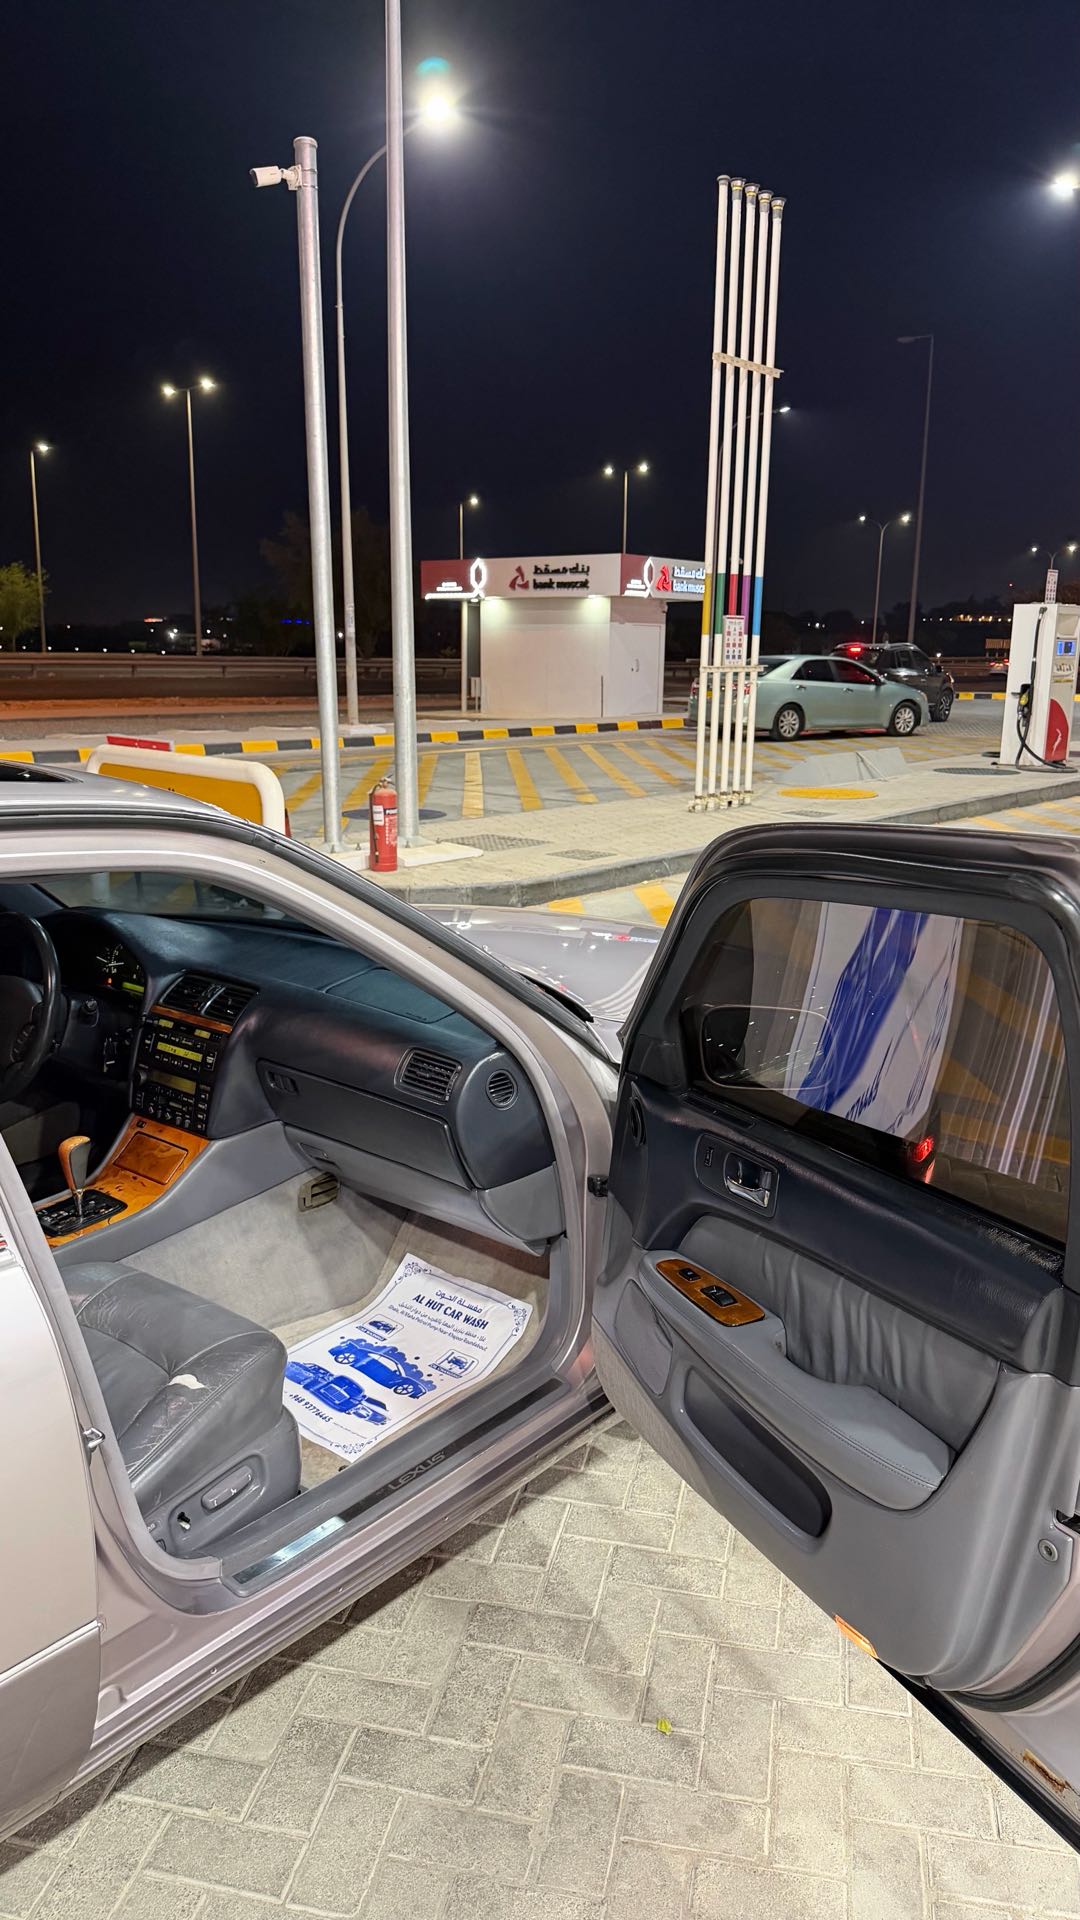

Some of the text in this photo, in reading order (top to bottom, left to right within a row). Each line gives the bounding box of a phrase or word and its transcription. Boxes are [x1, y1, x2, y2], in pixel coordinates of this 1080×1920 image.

[533, 562, 590, 577] بنك مسقط
[533, 578, 590, 590] bank muscat
[672, 580, 689, 592] bank
[435, 1289, 483, 1314] مغسلة الحوت
[412, 1294, 489, 1330] AL HUT CAR WASH
[388, 1451, 446, 1490] LEXUS
